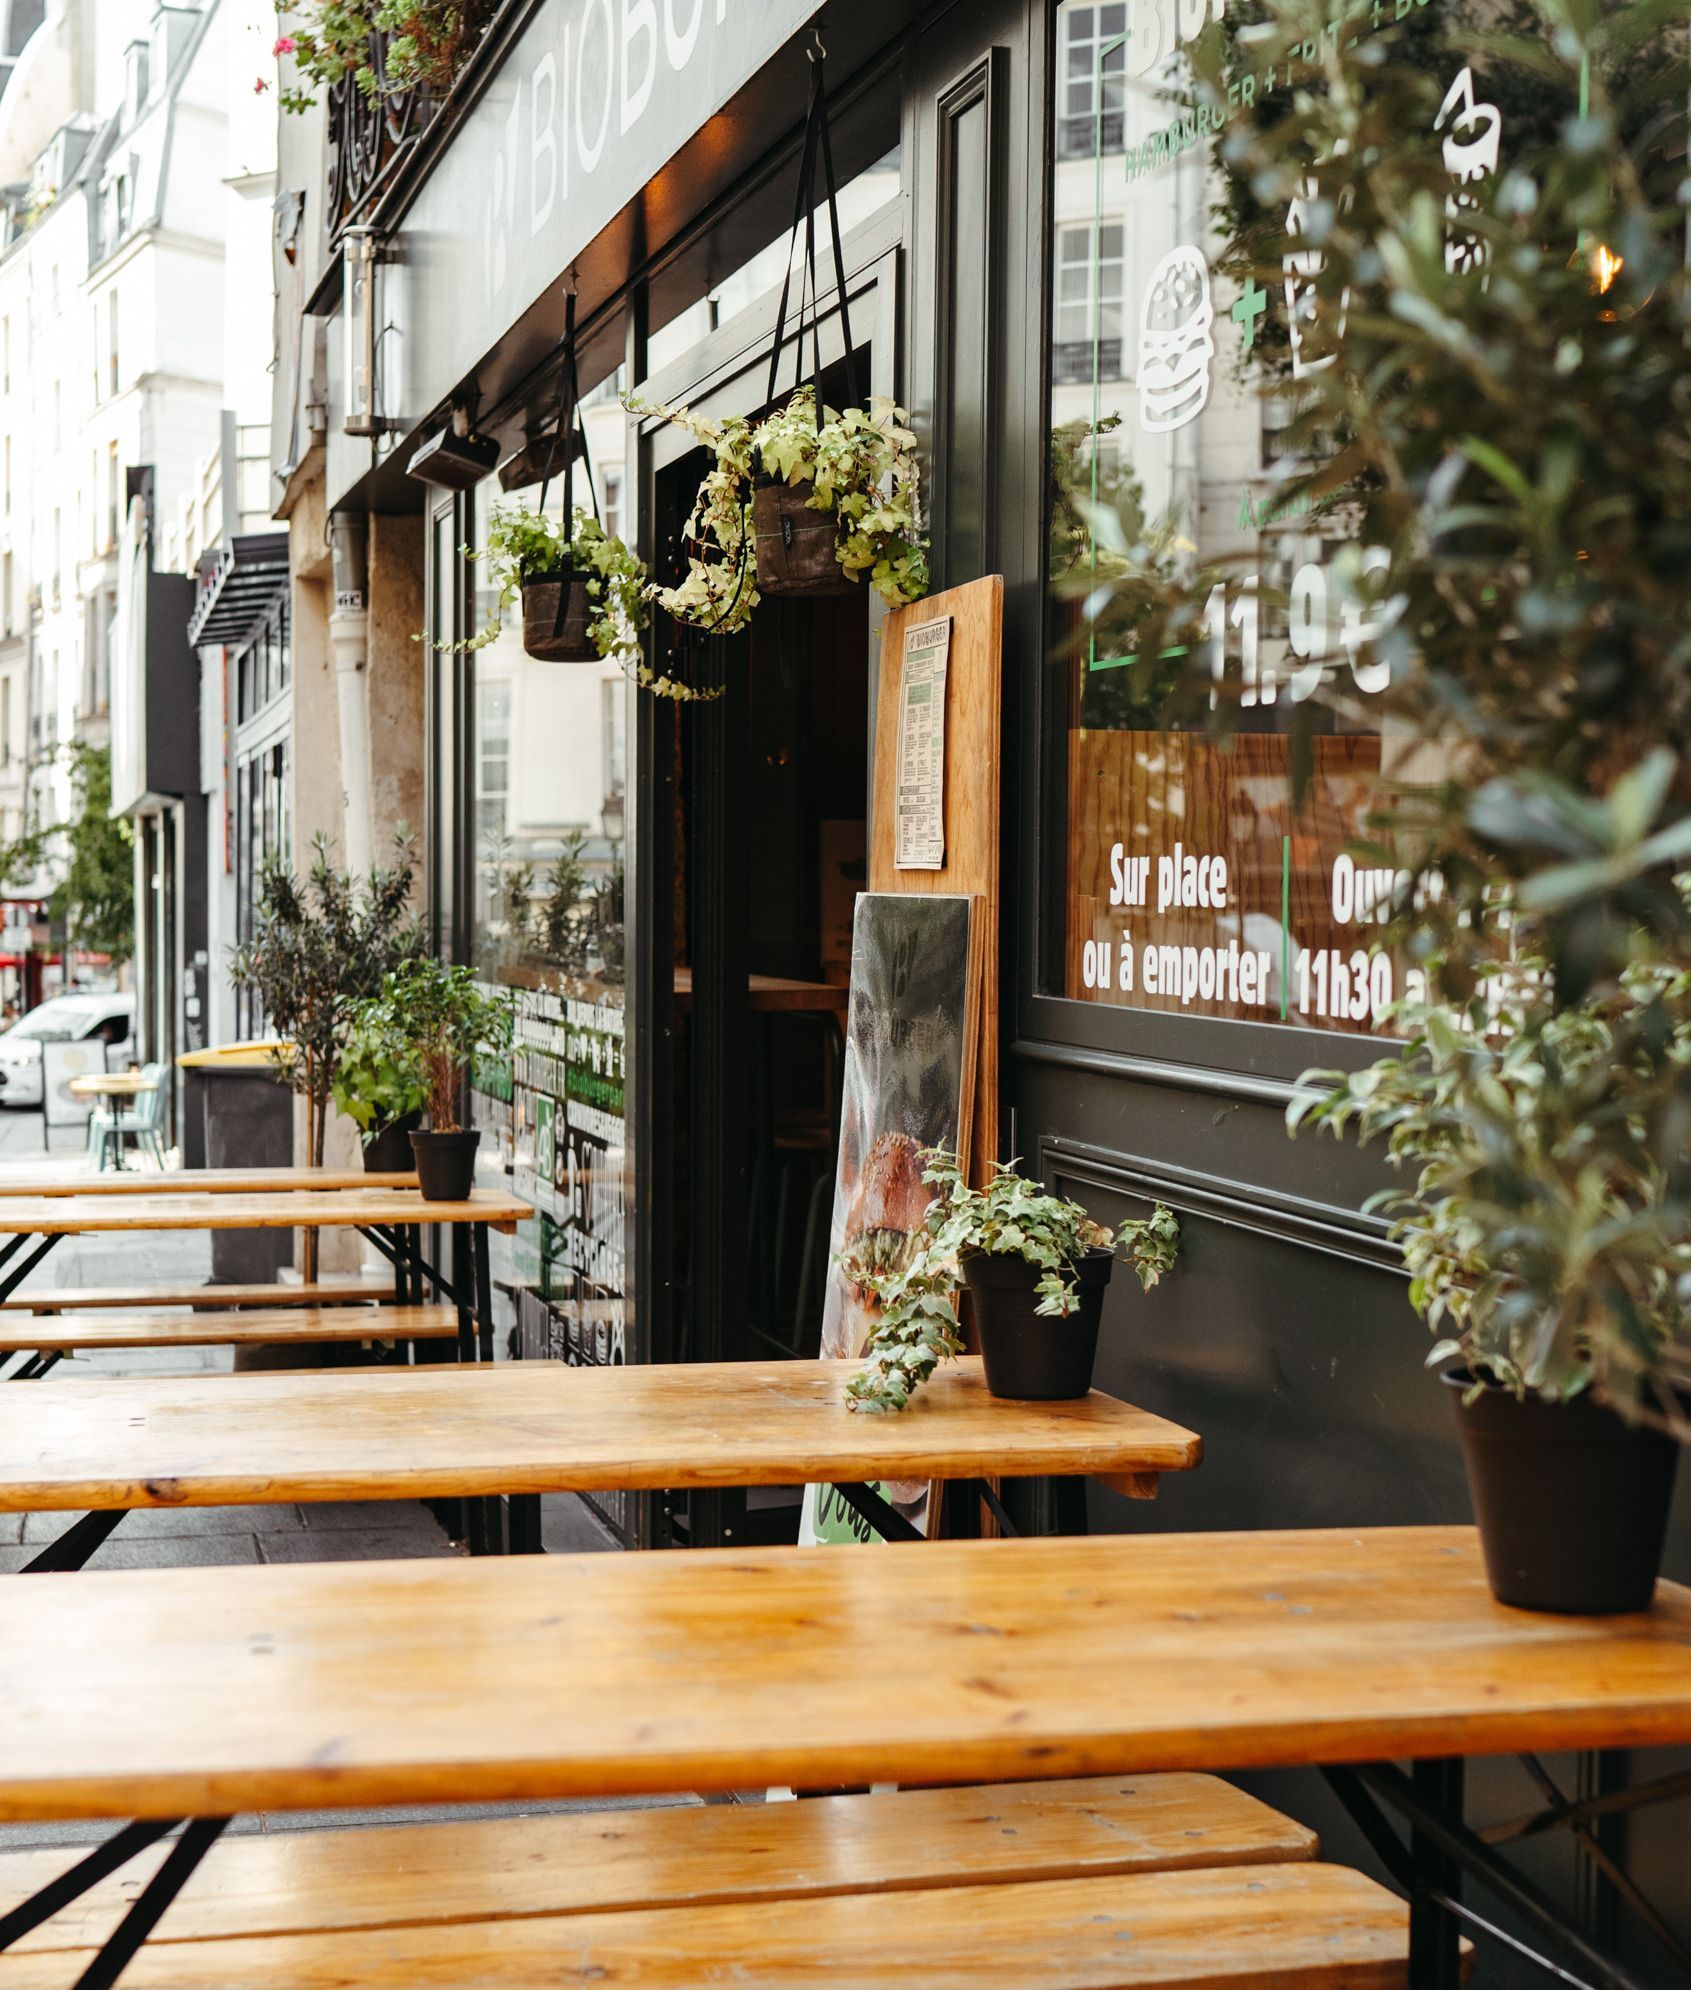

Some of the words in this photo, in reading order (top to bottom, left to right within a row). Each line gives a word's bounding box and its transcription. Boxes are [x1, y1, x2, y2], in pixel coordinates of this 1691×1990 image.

[1110, 843, 1150, 906] Sur
[1158, 842, 1227, 913] place
[1083, 940, 1111, 988] ou
[1119, 930, 1134, 991] à
[1143, 939, 1271, 1005] emporter
[1294, 948, 1393, 1021] 11h30
